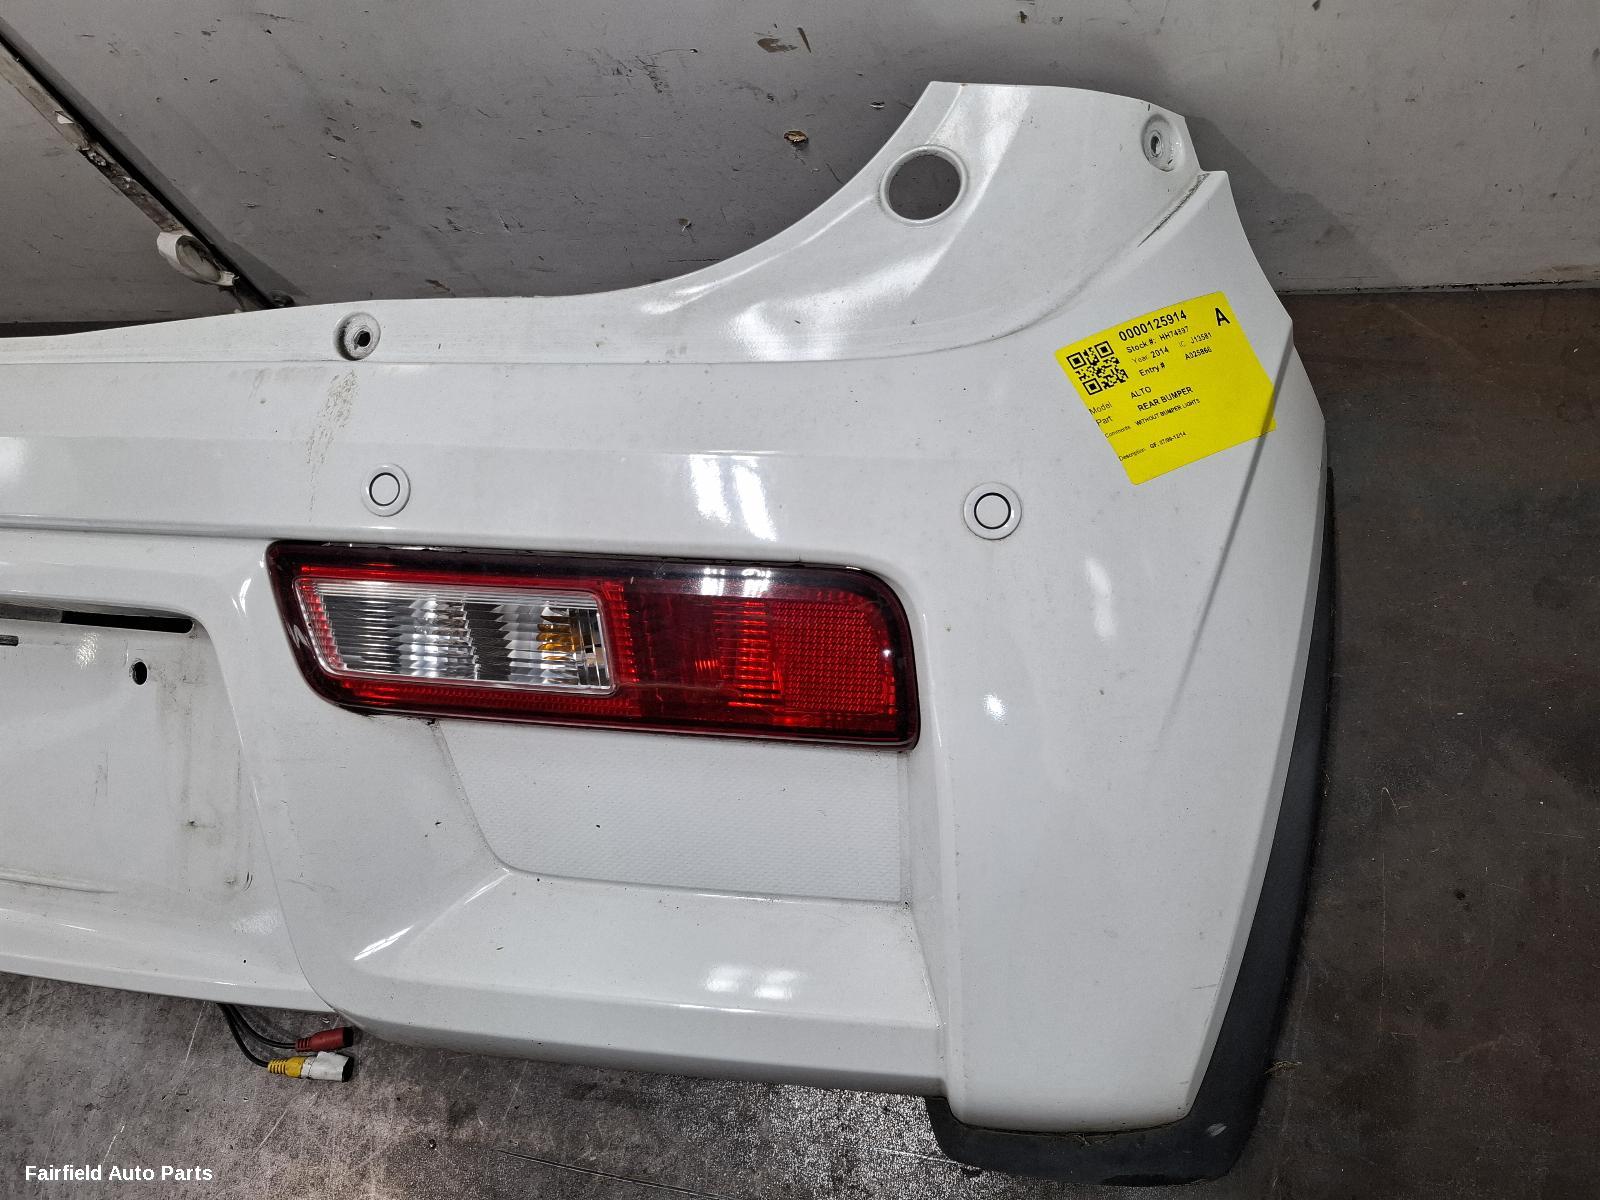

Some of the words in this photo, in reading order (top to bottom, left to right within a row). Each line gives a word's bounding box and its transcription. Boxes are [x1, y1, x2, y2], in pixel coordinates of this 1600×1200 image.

[1119, 310, 1187, 341] 0000125914
[1215, 308, 1230, 326] A
[1126, 341, 1148, 353] Stock
[1150, 346, 1169, 359] 2014
[1139, 365, 1160, 377] Entry
[1088, 401, 1113, 415] Model
[1130, 386, 1152, 399] ALTO
[1095, 415, 1113, 426] Part
[1137, 398, 1161, 412] REAR
[1160, 386, 1194, 403] BUMPER
[1135, 413, 1159, 426] WITHOUT
[1160, 405, 1182, 417] BUMPER
[1182, 398, 1201, 409] LIGHTS
